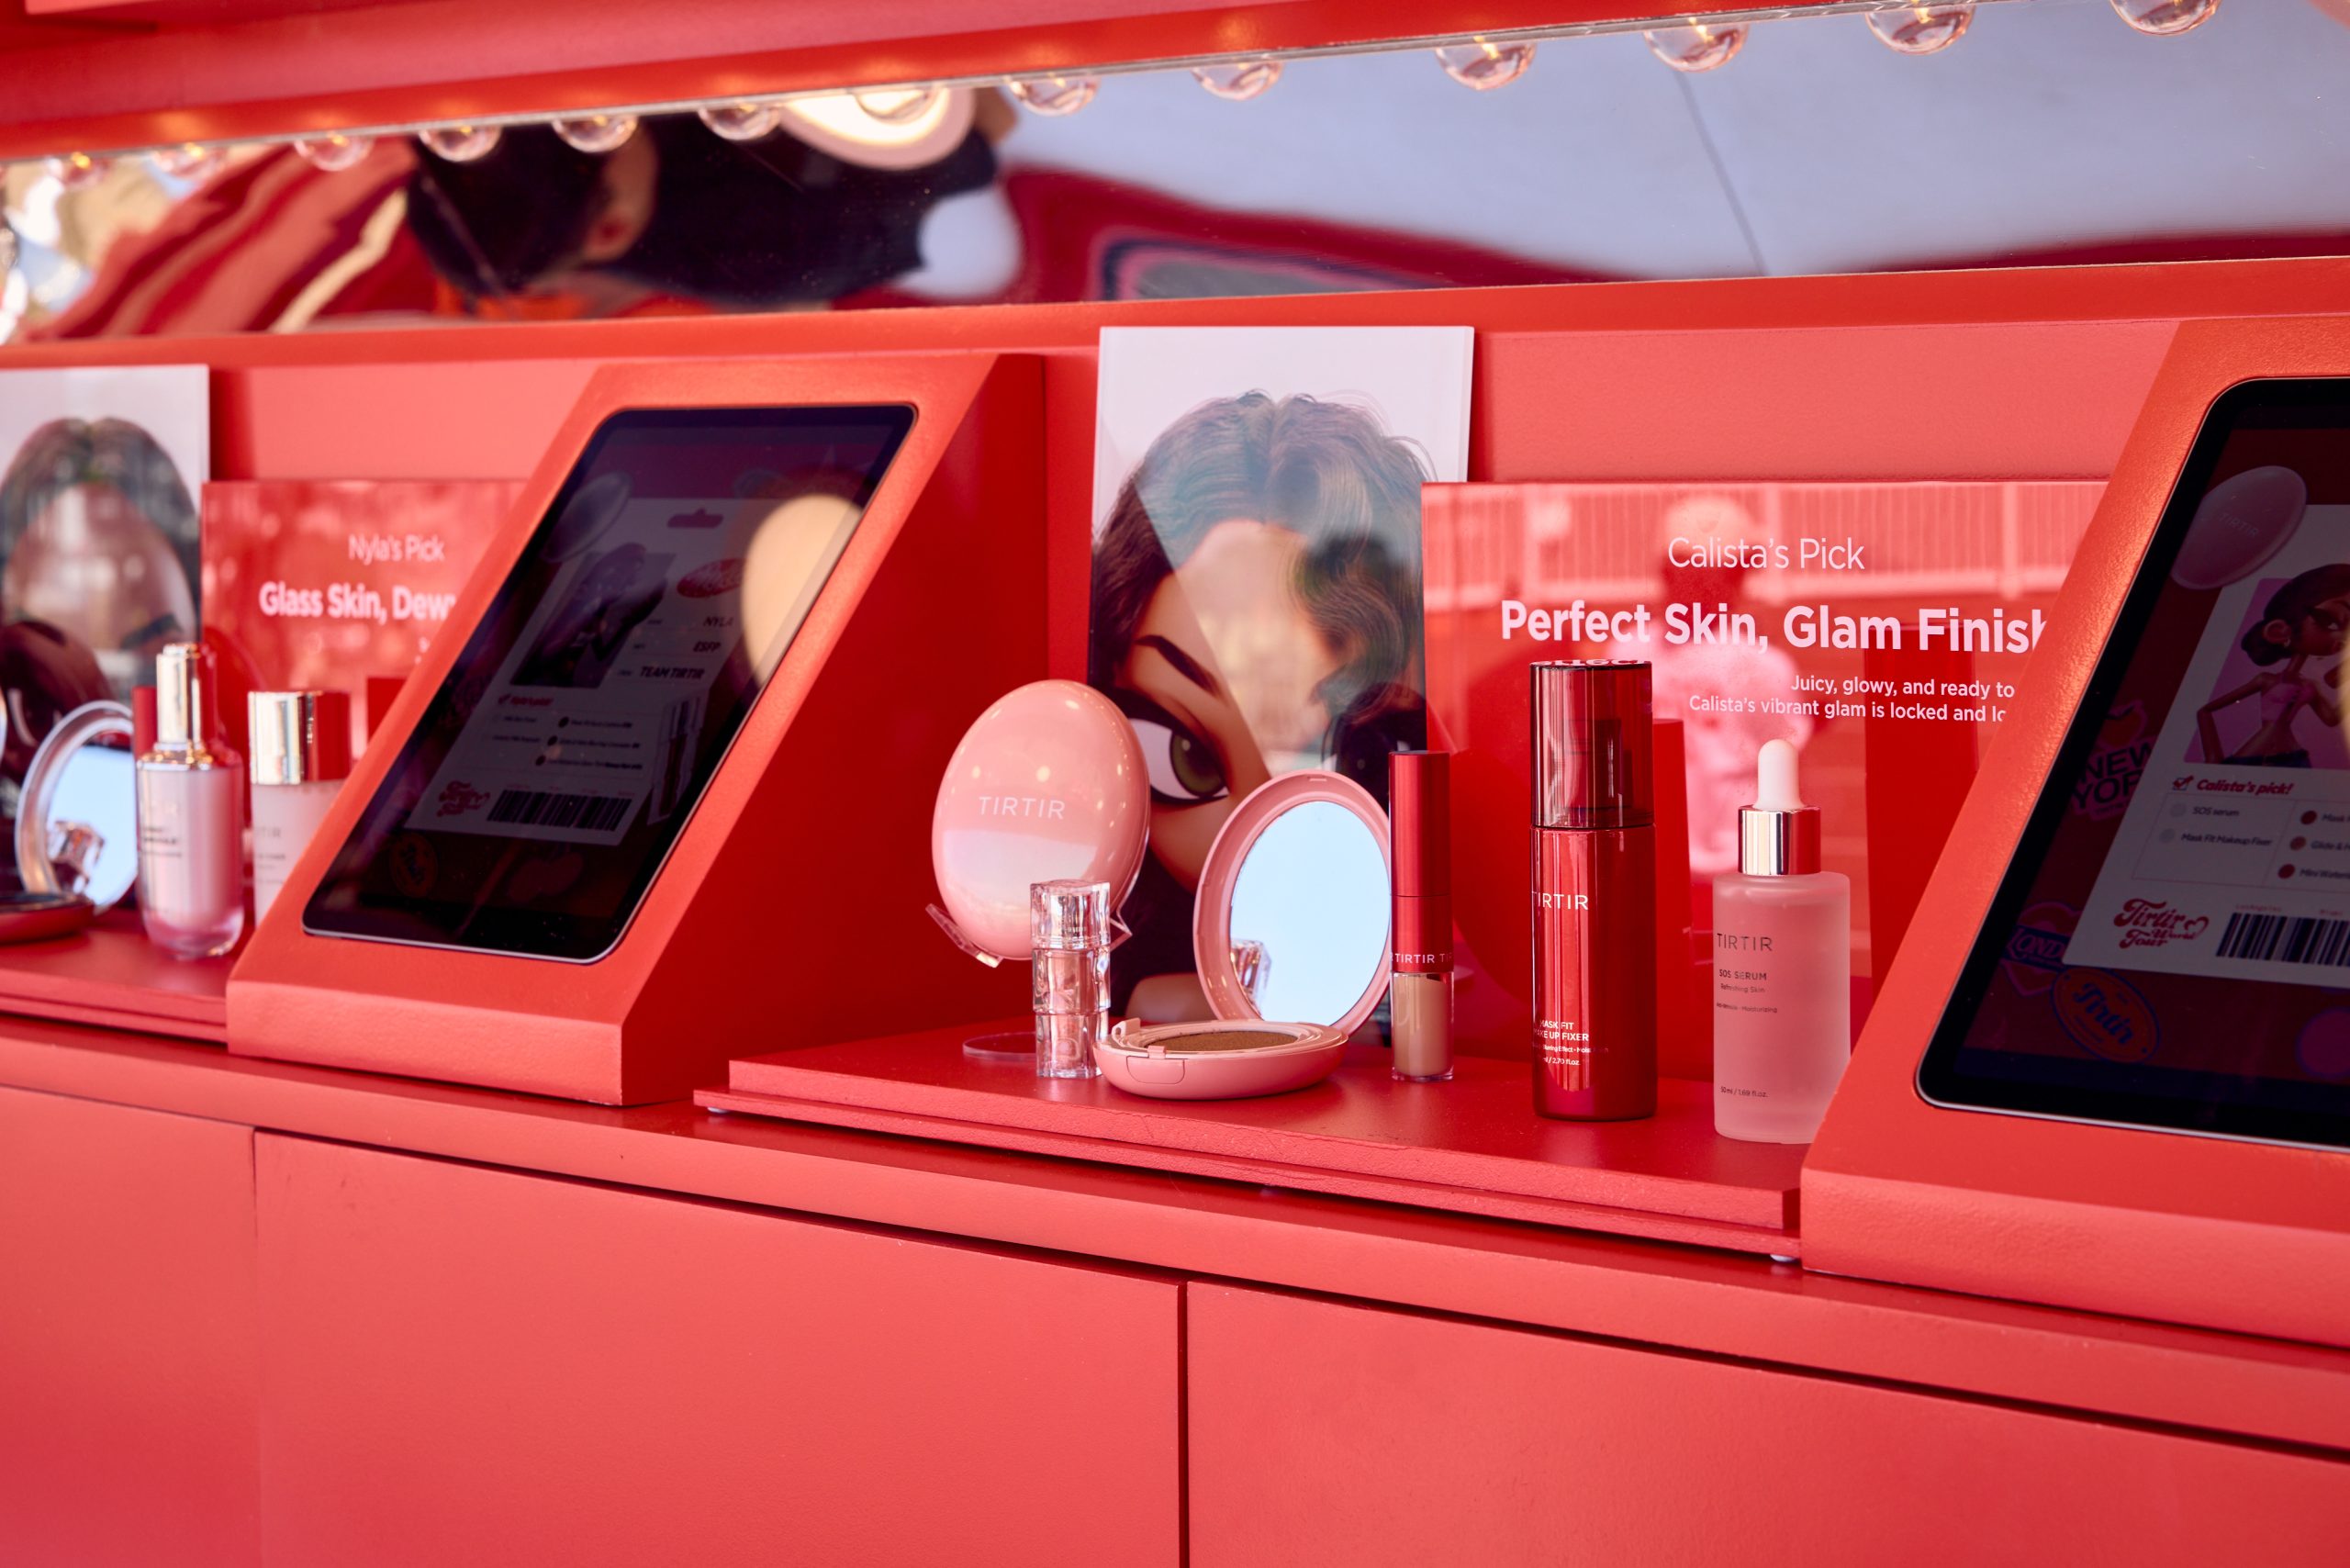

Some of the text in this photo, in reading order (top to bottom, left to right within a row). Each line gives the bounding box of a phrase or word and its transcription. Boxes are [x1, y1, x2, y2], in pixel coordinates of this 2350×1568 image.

[348, 534, 445, 566] Nyla's Pick
[1668, 536, 1865, 570] Calista's Pick
[259, 581, 455, 625] Glass Skin, Dew
[1501, 599, 1651, 643] Perfect
[1664, 602, 1768, 655] Skin,
[1784, 604, 1901, 650] Glam
[1791, 675, 2015, 700] Juicy, glowy, and ready to
[1689, 694, 1756, 713] Calista's
[1761, 697, 1819, 715] vibrant
[1824, 700, 1866, 719] glam
[1872, 700, 1885, 718] is
[1890, 702, 1948, 720] locked
[1953, 704, 1986, 722] and
[2197, 778, 2294, 796] Calista's pick!
[979, 796, 1065, 820] TIRTIR
[2193, 806, 2240, 816] SOS serum
[1717, 933, 1773, 952] TIRTIR
[1394, 953, 1436, 964] TIRTIR
[1719, 969, 1767, 980] SOS SERUM
[1539, 1020, 1574, 1030] MASK FIT
[1550, 1031, 1560, 1039] UP
[1561, 1033, 1589, 1041] FIXER
